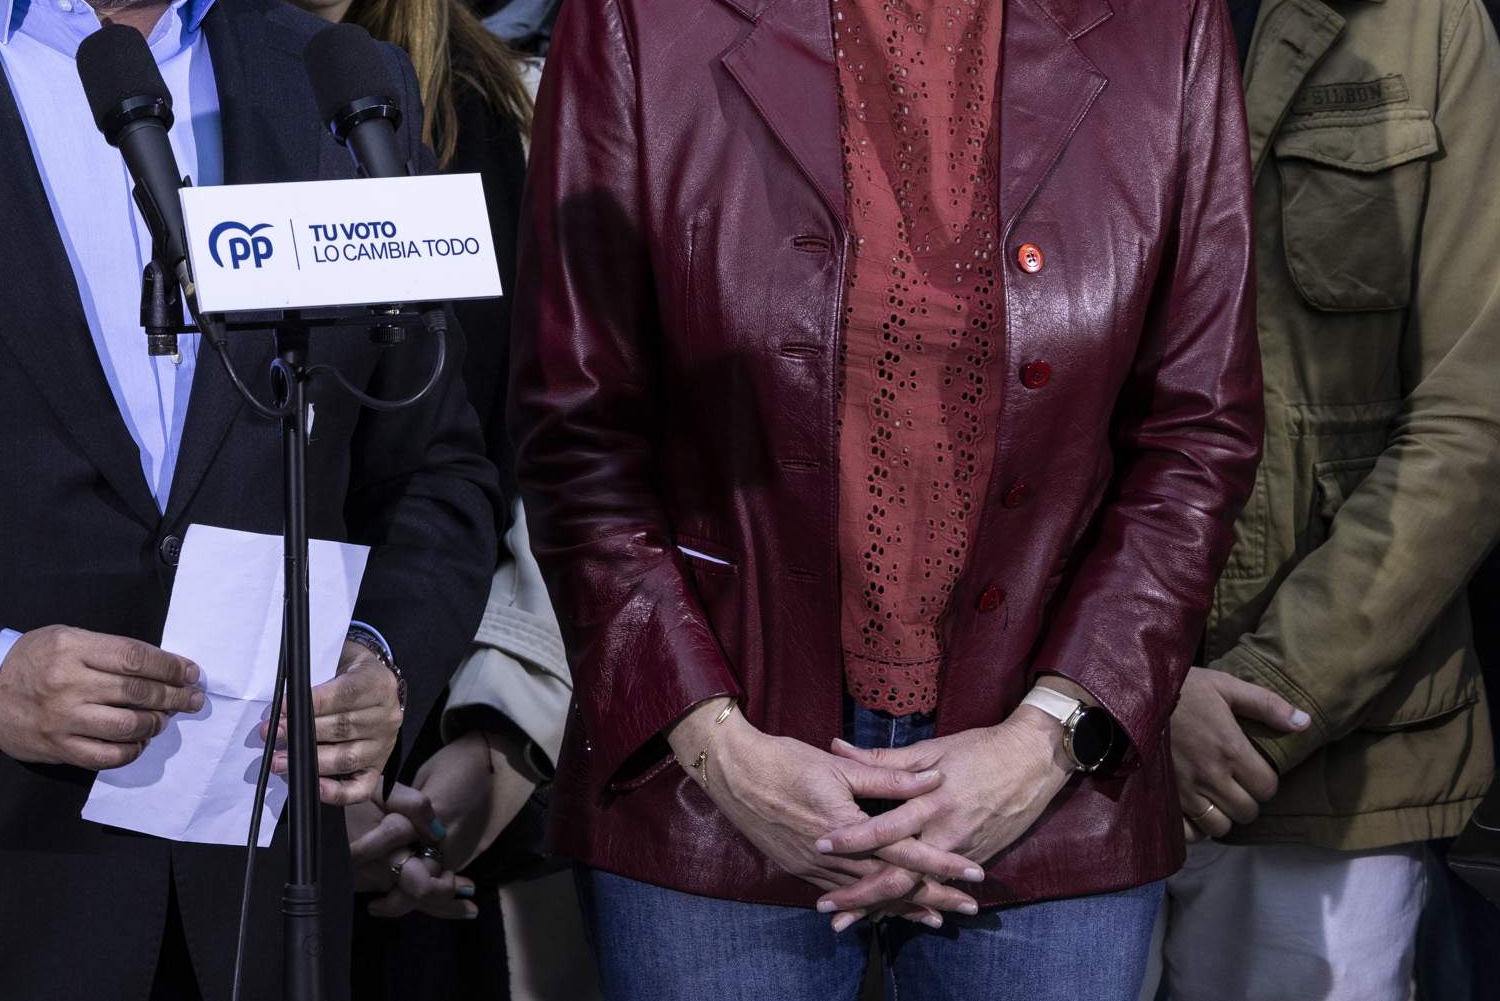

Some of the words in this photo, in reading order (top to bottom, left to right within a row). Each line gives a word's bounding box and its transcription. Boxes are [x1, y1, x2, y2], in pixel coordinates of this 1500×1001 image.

[308, 223, 338, 242] TU
[339, 220, 397, 241] VOTO
[313, 243, 340, 263] LO
[342, 240, 422, 262] CAMBIA
[422, 237, 480, 257] TODO
